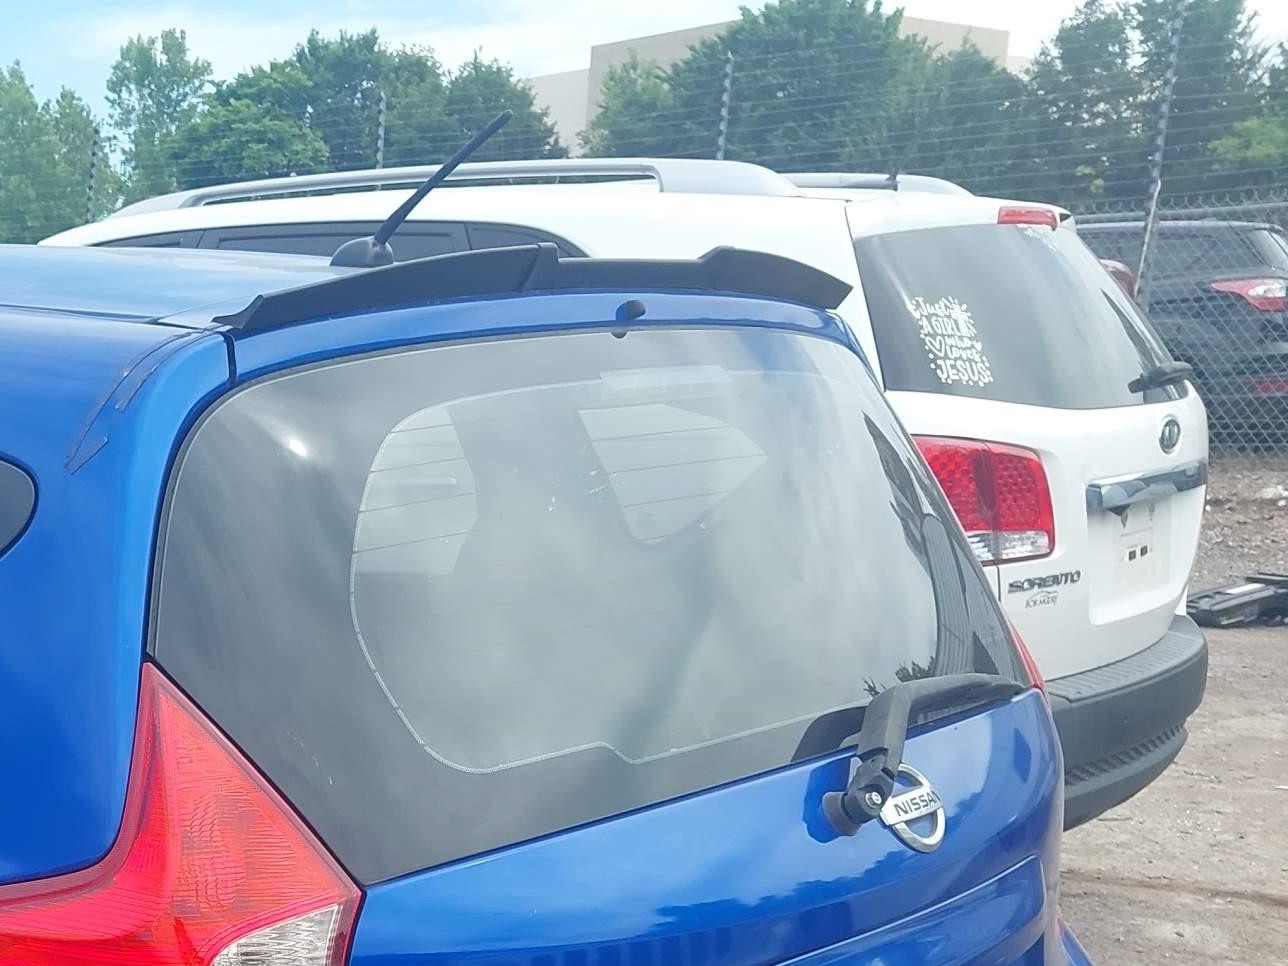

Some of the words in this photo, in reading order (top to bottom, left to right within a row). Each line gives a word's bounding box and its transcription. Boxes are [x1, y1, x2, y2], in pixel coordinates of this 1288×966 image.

[915, 297, 951, 316] Just
[922, 317, 933, 334] A
[936, 360, 990, 383] JESUS
[1008, 570, 1081, 594] SORENTO
